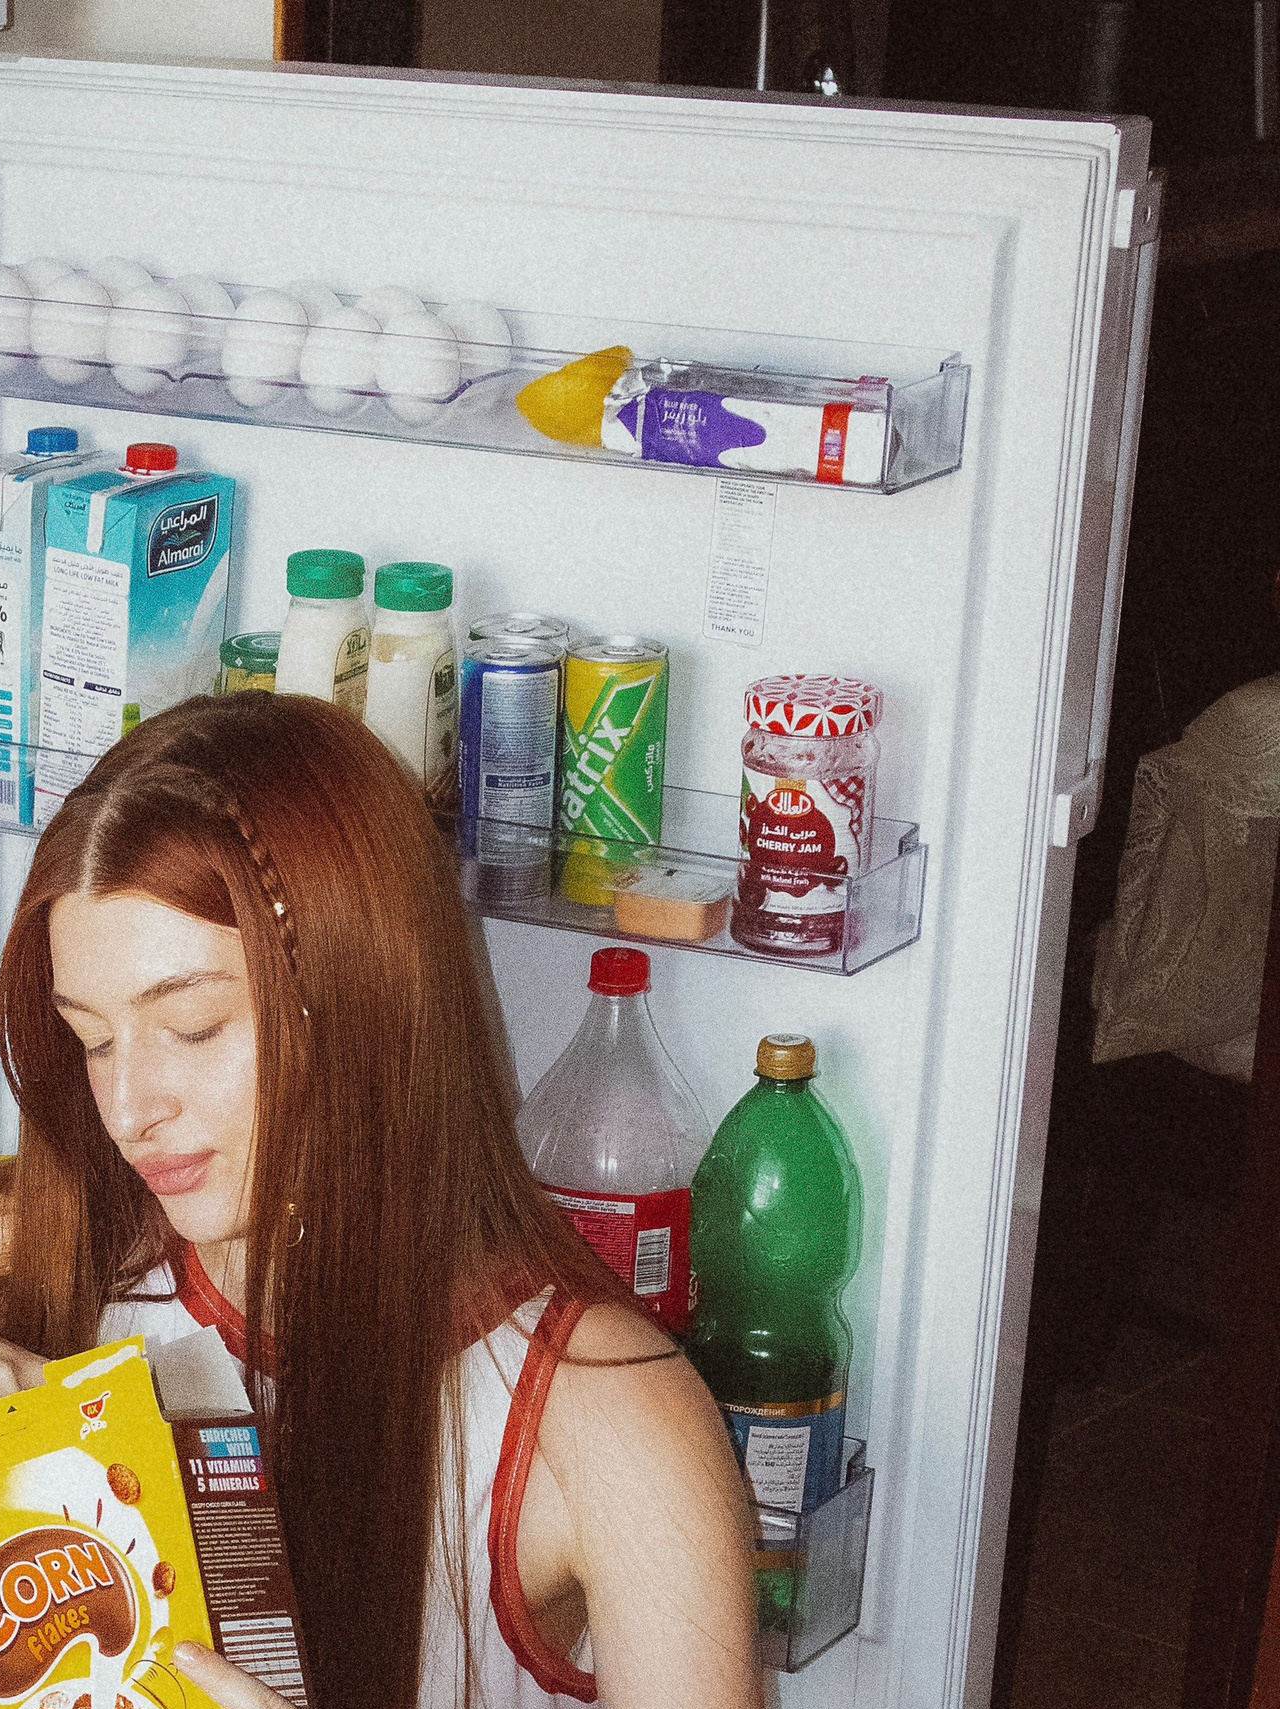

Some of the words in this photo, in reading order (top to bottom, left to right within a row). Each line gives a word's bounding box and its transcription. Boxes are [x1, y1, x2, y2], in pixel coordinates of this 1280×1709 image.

[160, 504, 208, 534] المراعي
[158, 541, 204, 567] Almarai
[54, 566, 69, 577] LONG
[69, 570, 80, 579] LIFE
[80, 572, 93, 582] LOW
[94, 575, 105, 584] FAT
[105, 578, 119, 588] MILK
[711, 623, 736, 634] THANK
[738, 628, 755, 637] YOU
[769, 792, 812, 815] العلالي
[761, 823, 788, 836] الكرز
[790, 829, 817, 840] مربى
[756, 838, 796, 853] CHERRY
[797, 843, 822, 853] JAM
[725, 1403, 786, 1416] ТОРОЖДЕНИЕ
[199, 1428, 251, 1443] ENRICHED
[226, 1442, 254, 1456] WITH
[189, 1459, 204, 1475] 11
[206, 1459, 257, 1474] VITAMINS
[197, 1477, 206, 1493] 5
[208, 1477, 260, 1492] MINERALS
[27, 1604, 91, 1666] flakes
